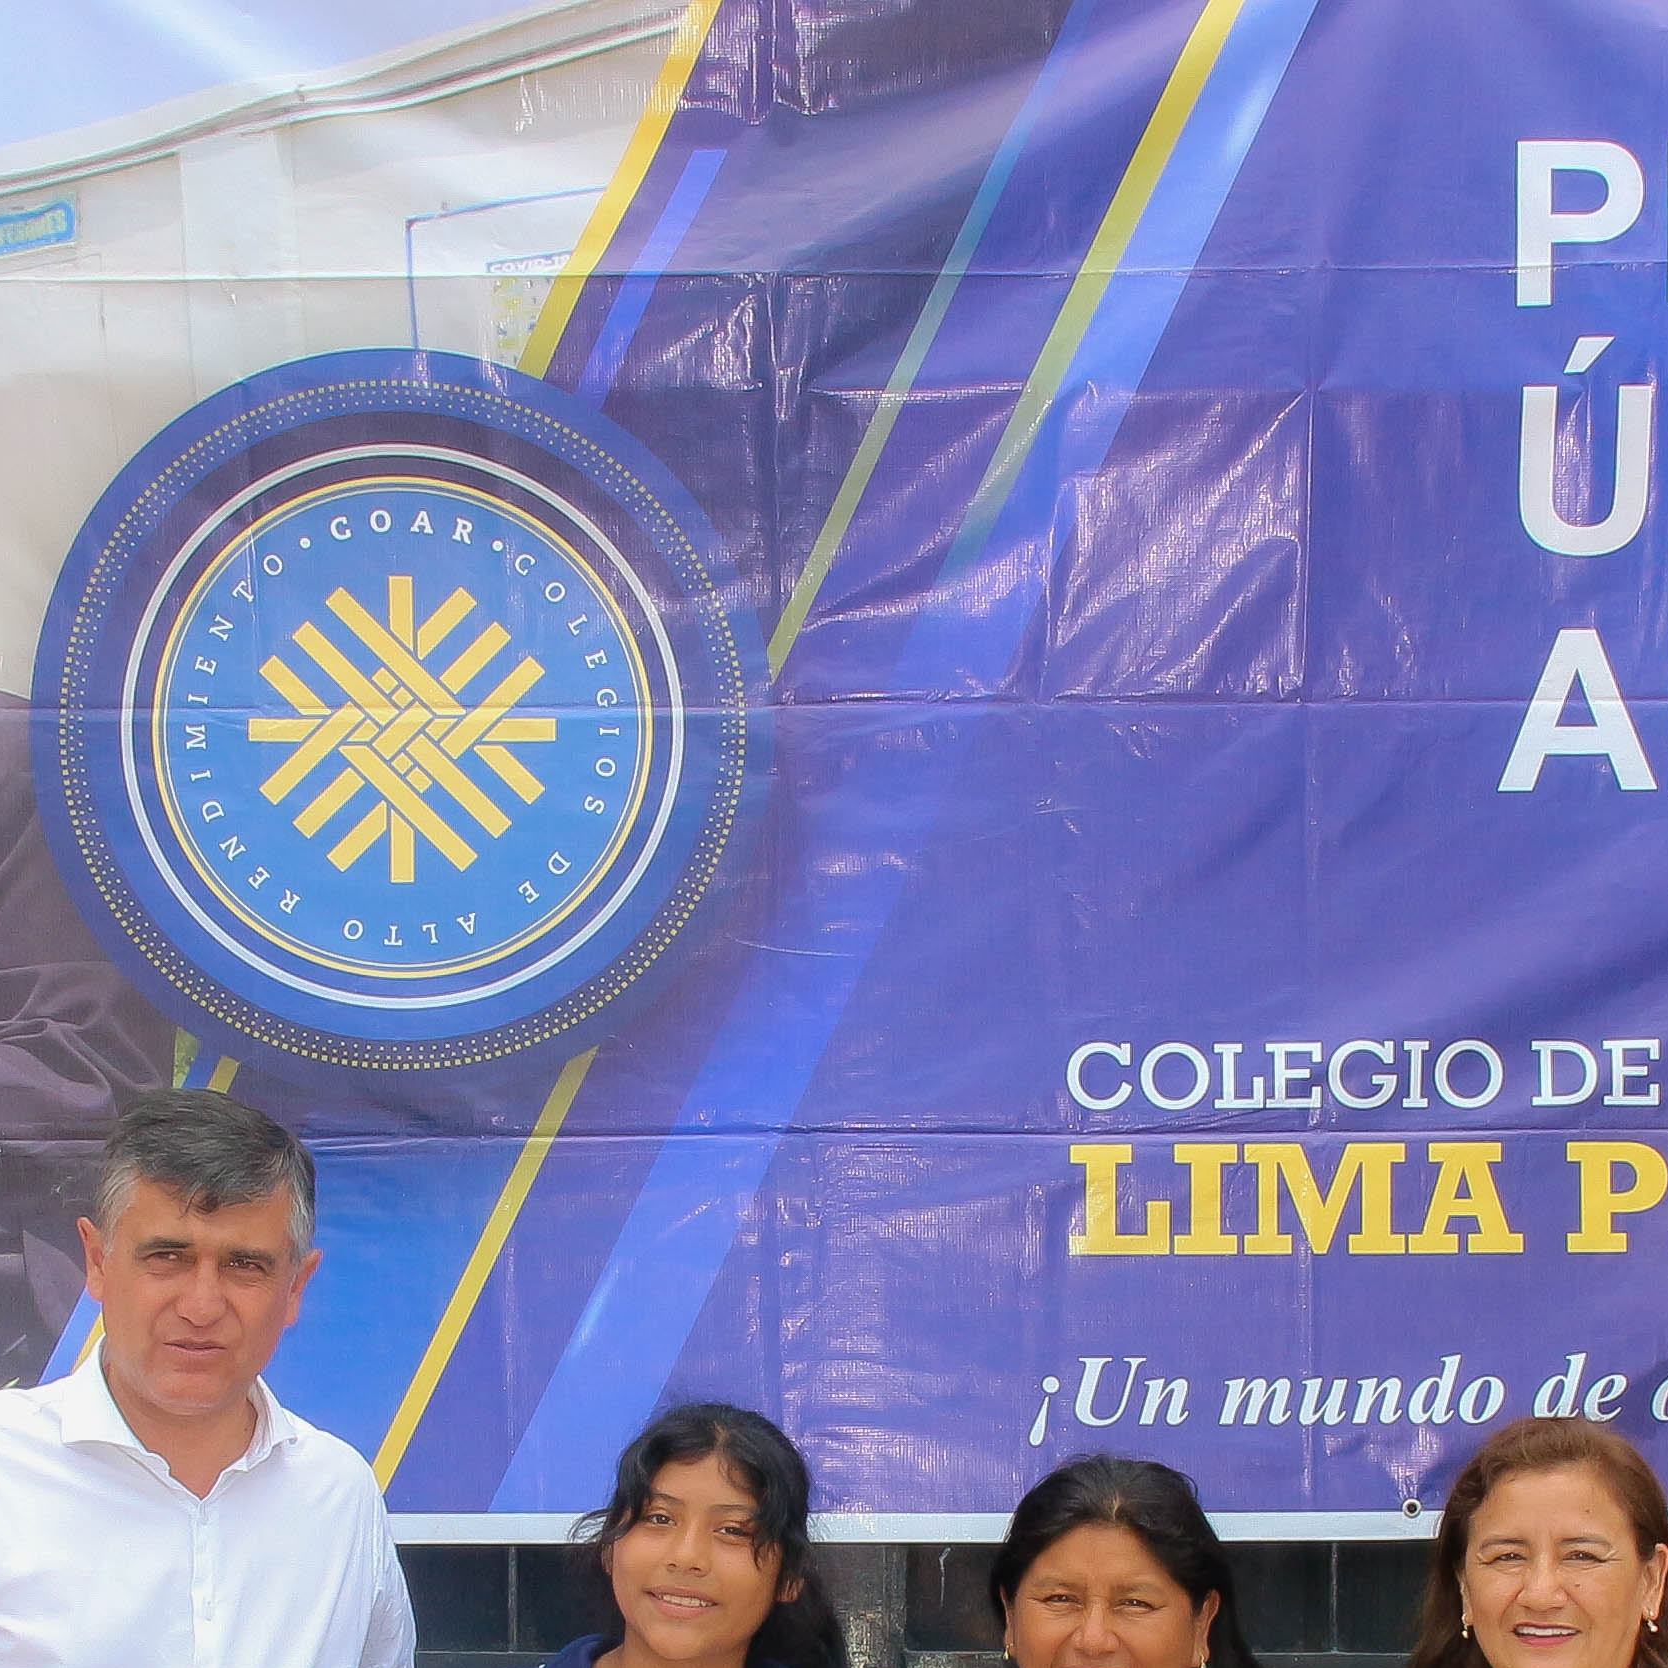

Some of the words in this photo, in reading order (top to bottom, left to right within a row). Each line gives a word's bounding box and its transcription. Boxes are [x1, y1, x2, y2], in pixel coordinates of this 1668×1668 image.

[329, 508, 477, 544] COAR
[512, 552, 619, 817] COLEGIOS
[185, 552, 301, 914] RENDIMIENTO
[517, 852, 573, 906] DE
[343, 910, 478, 947] ALTO
[1067, 1041, 1502, 1111] COLEGIO
[1531, 1040, 1660, 1107] DE
[1068, 1141, 1525, 1256] LIMA
[1028, 1358, 1202, 1447] ¡Un
[1219, 1354, 1505, 1428] mundo
[1534, 1353, 1627, 1421] de
